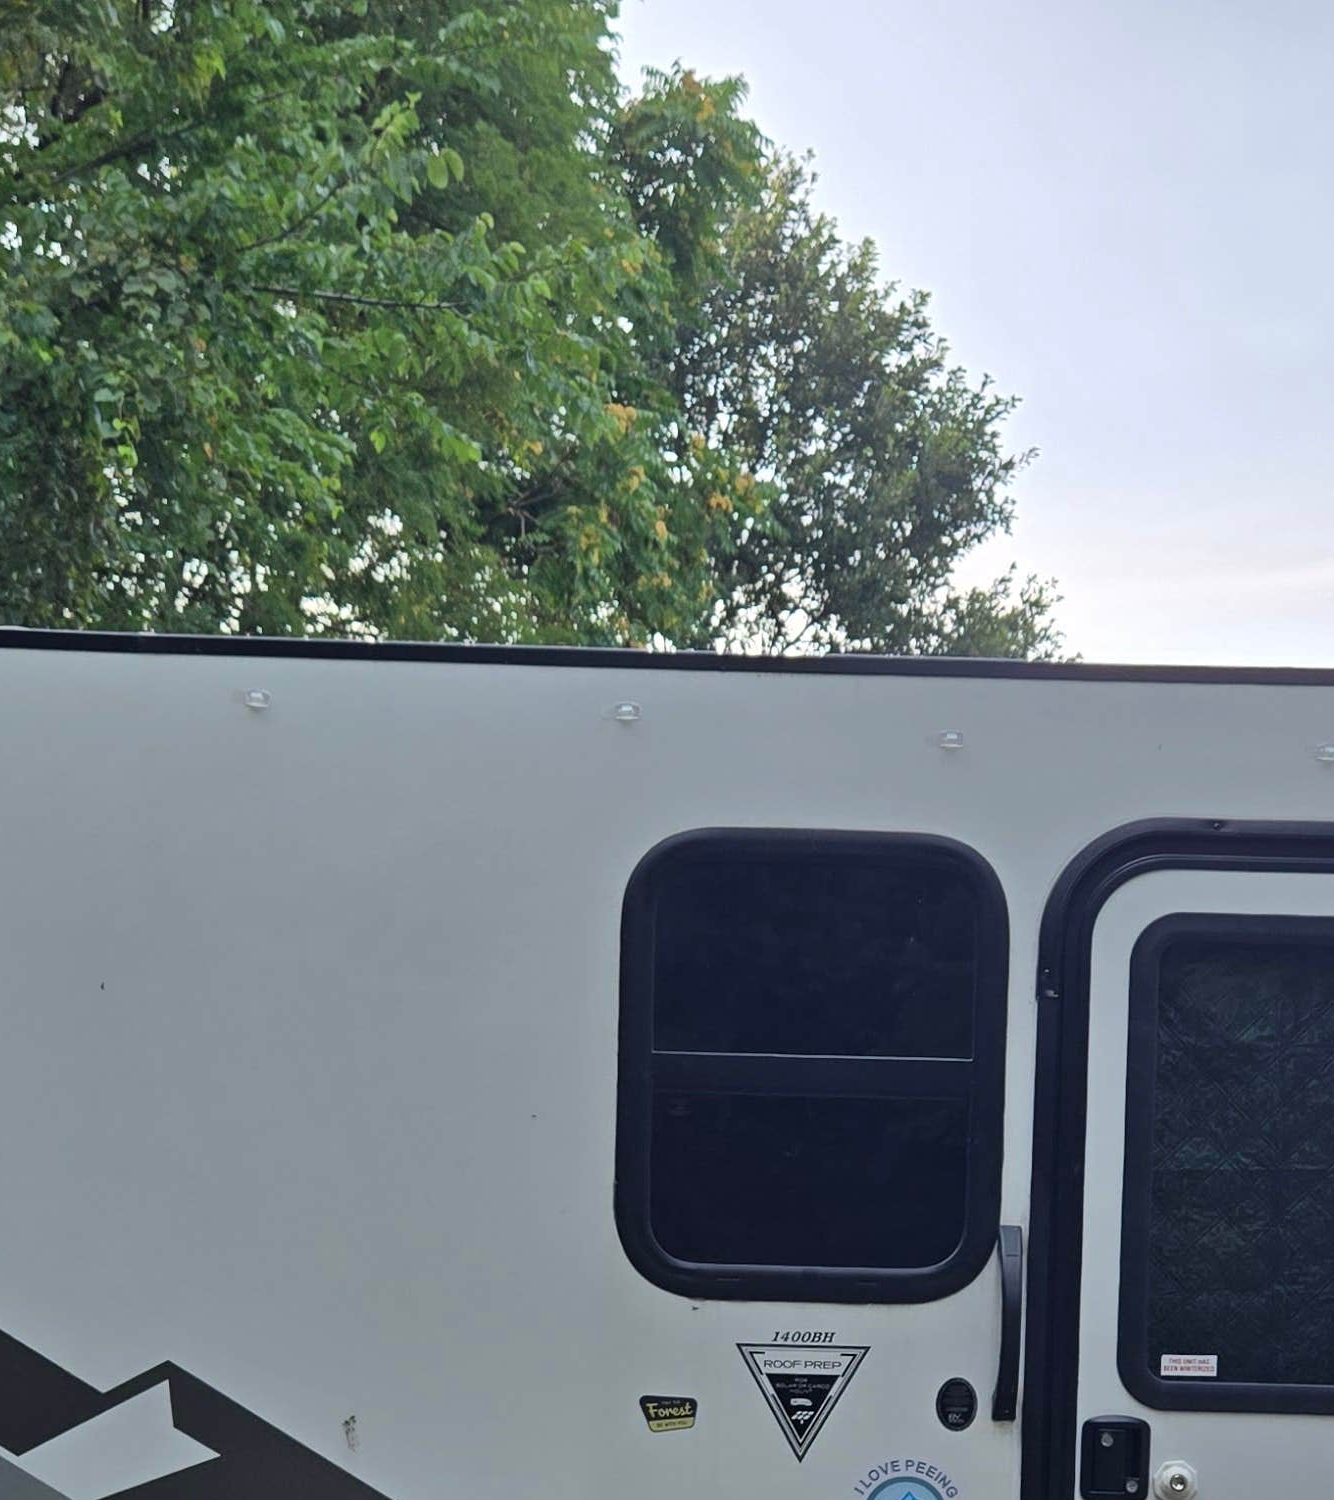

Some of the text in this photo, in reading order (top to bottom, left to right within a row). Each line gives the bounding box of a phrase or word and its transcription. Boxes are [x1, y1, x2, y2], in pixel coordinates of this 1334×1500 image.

[771, 1331, 835, 1343] 1400BH
[764, 1359, 842, 1370] ROOF PREP
[646, 1402, 693, 1418] Forest
[859, 1460, 901, 1490] LOVE
[905, 1459, 959, 1499] PEEING
